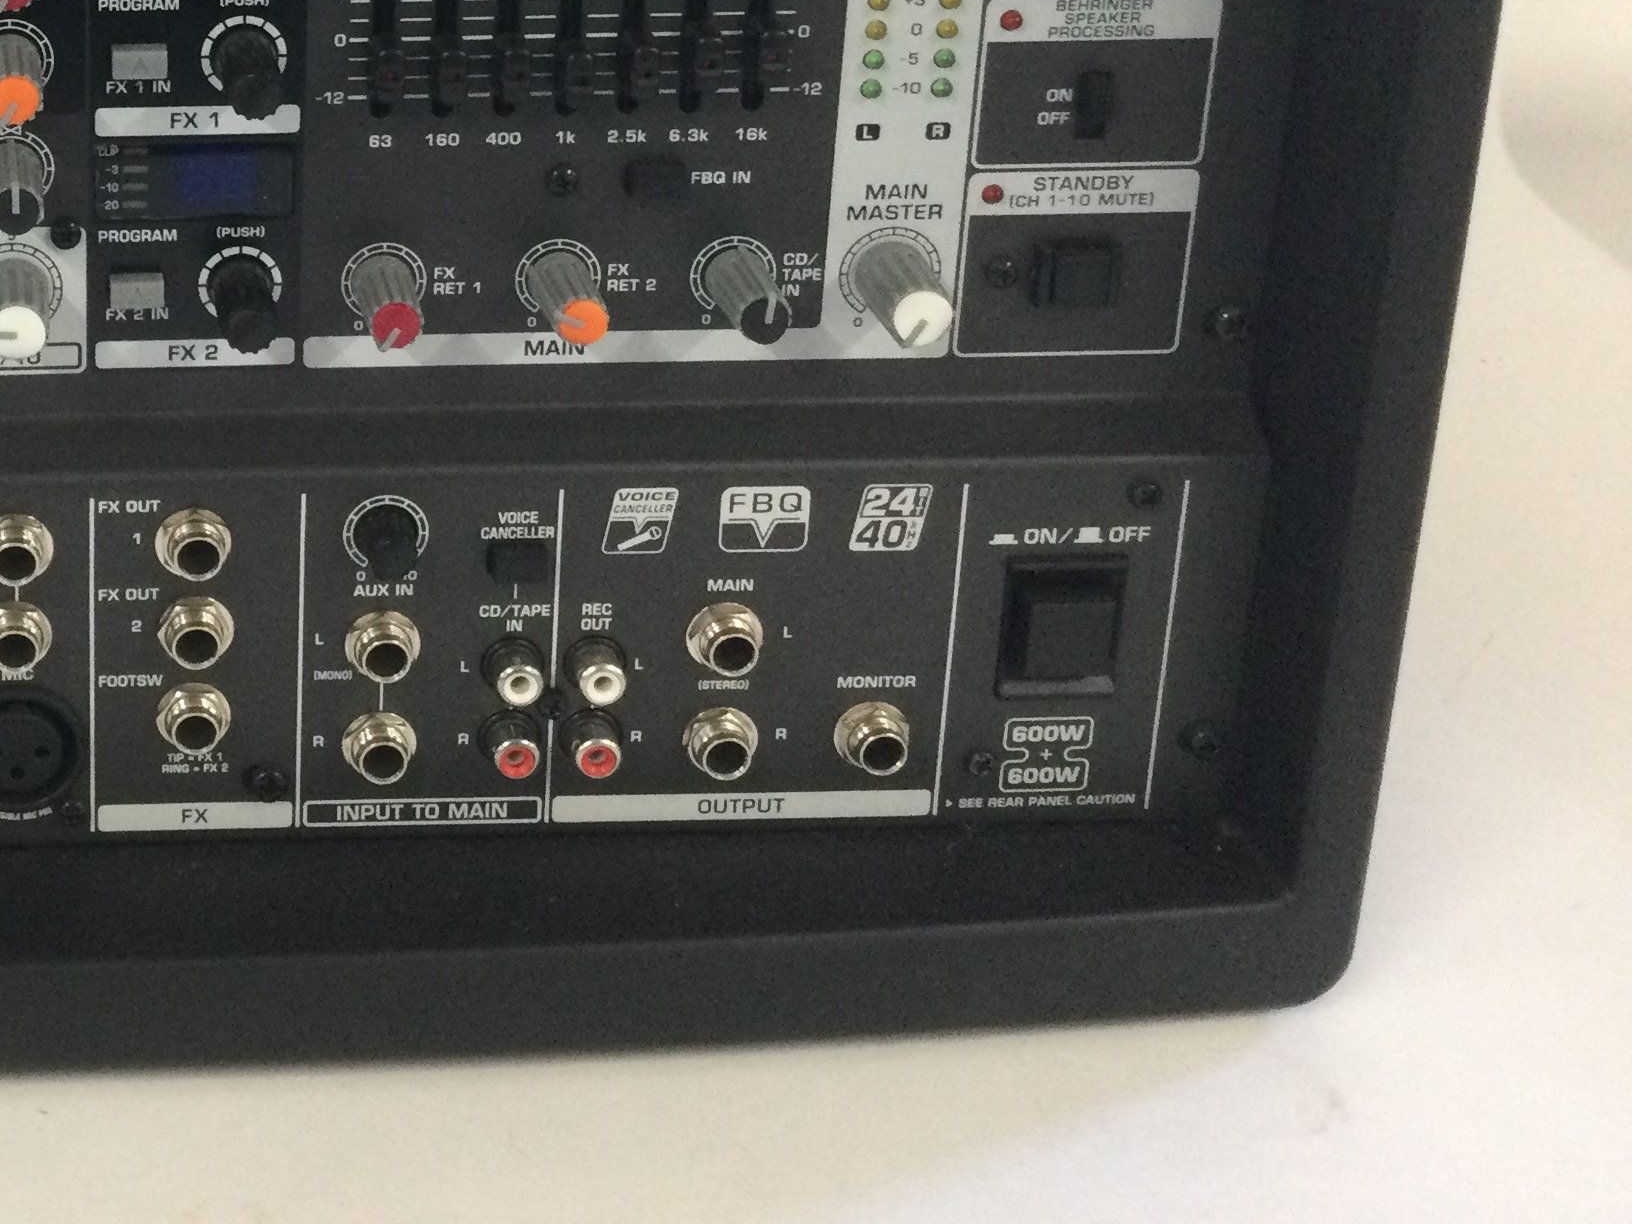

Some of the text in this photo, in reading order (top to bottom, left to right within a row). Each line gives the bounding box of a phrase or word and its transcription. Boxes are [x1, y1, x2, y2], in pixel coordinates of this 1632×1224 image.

[1064, 11, 1141, 24] SPEAKER
[1047, 25, 1155, 38] PROCESSING
[1046, 89, 1073, 102] ON
[171, 112, 219, 128] FX 1
[1037, 112, 1071, 126] OFF
[1033, 176, 1134, 192] STANDBY
[866, 184, 928, 200] MAIN
[1049, 194, 1091, 208] 1-10
[847, 204, 942, 221] MASTER
[98, 229, 178, 243] PROGRAM
[169, 345, 218, 361] FX 2
[618, 490, 676, 501] VOICE
[98, 500, 161, 514] FX OUT
[613, 503, 674, 514] CANCELLER
[729, 493, 803, 513] FBQ
[498, 511, 539, 524] VOICE
[480, 526, 555, 540] CANCELLER
[1109, 527, 1152, 543] OFF
[353, 583, 414, 598] AUX IN
[706, 579, 754, 593] MAIN
[479, 604, 550, 619] CD/TAPE
[582, 603, 612, 616] REC
[506, 618, 522, 632] IN
[581, 617, 612, 631] OUT
[98, 674, 163, 688] FOOTSW
[836, 675, 916, 689] MONITOR
[1012, 725, 1086, 742] 600W
[1007, 766, 1080, 784] 600W
[697, 797, 784, 815] OUTPUT
[958, 793, 1136, 808] SEE REAR PANEL CAUTION
[181, 808, 208, 824] FX
[336, 802, 508, 821] INPUT TO MAIN
